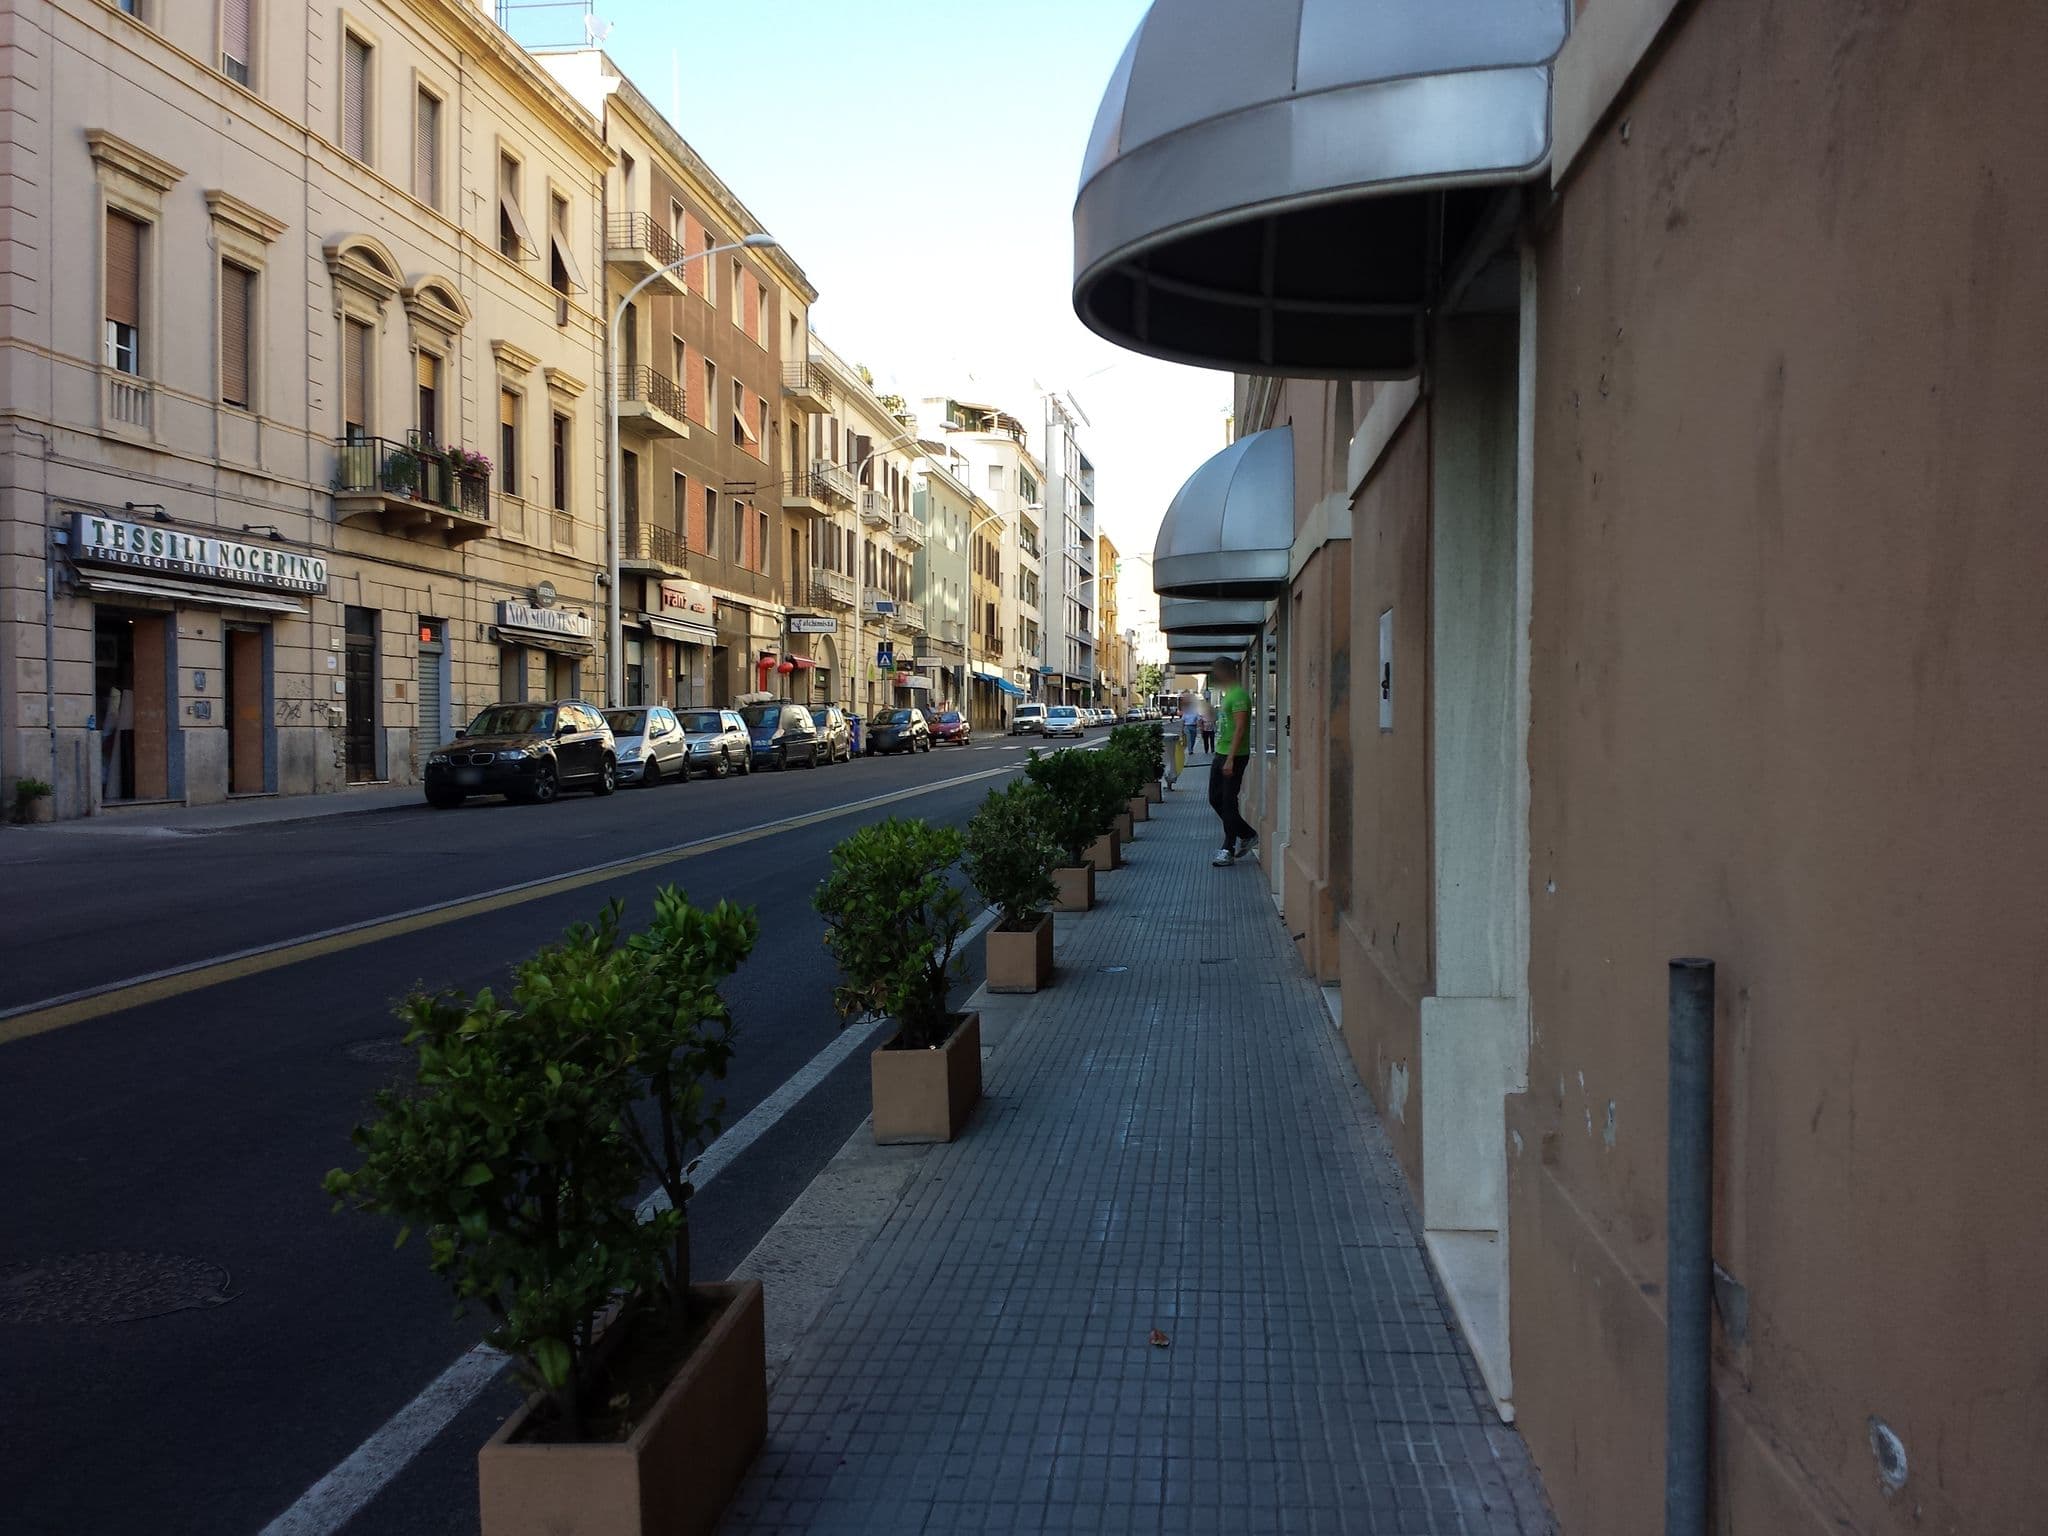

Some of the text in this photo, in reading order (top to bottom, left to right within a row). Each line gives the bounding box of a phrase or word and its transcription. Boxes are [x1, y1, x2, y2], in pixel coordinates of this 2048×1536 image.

[86, 546, 168, 570] TENDAGGI
[183, 562, 265, 583] BIANCHERIA
[276, 577, 324, 592] CORREDI
[92, 519, 324, 582] TESSILI NOCERINO
[508, 603, 529, 625] NON
[531, 609, 555, 630] SOLO
